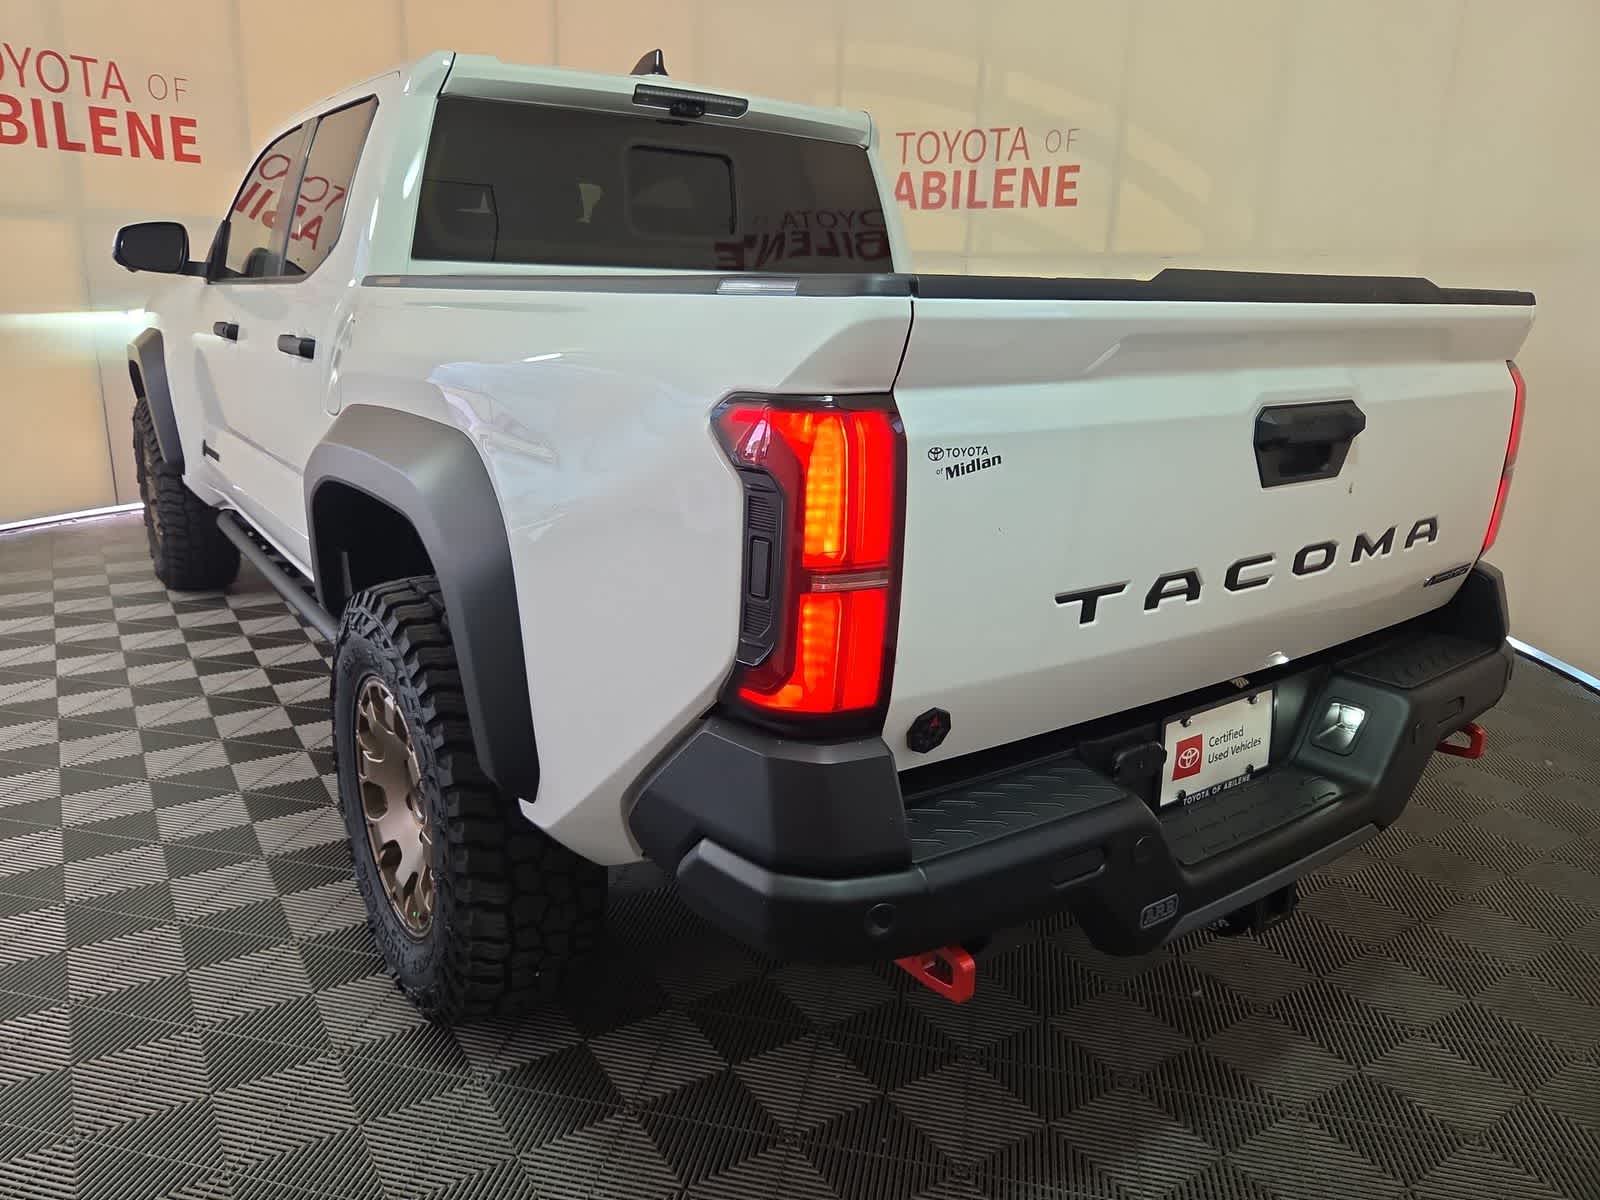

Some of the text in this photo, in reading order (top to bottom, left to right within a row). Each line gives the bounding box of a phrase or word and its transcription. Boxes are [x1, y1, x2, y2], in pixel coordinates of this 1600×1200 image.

[0, 42, 188, 103] YOTA OF
[0, 93, 201, 164] BILENE
[896, 127, 1080, 165] TOYOTA OF
[895, 165, 1081, 210] ABILENE
[945, 446, 989, 458] TOYOTA
[945, 455, 1002, 480] Midlan
[1054, 516, 1439, 626] TACOMA
[1207, 737, 1262, 764] Used Vehicles
[1208, 724, 1244, 748] Certified
[1183, 790, 1210, 806] TOYOTA
[1211, 785, 1222, 795] OF
